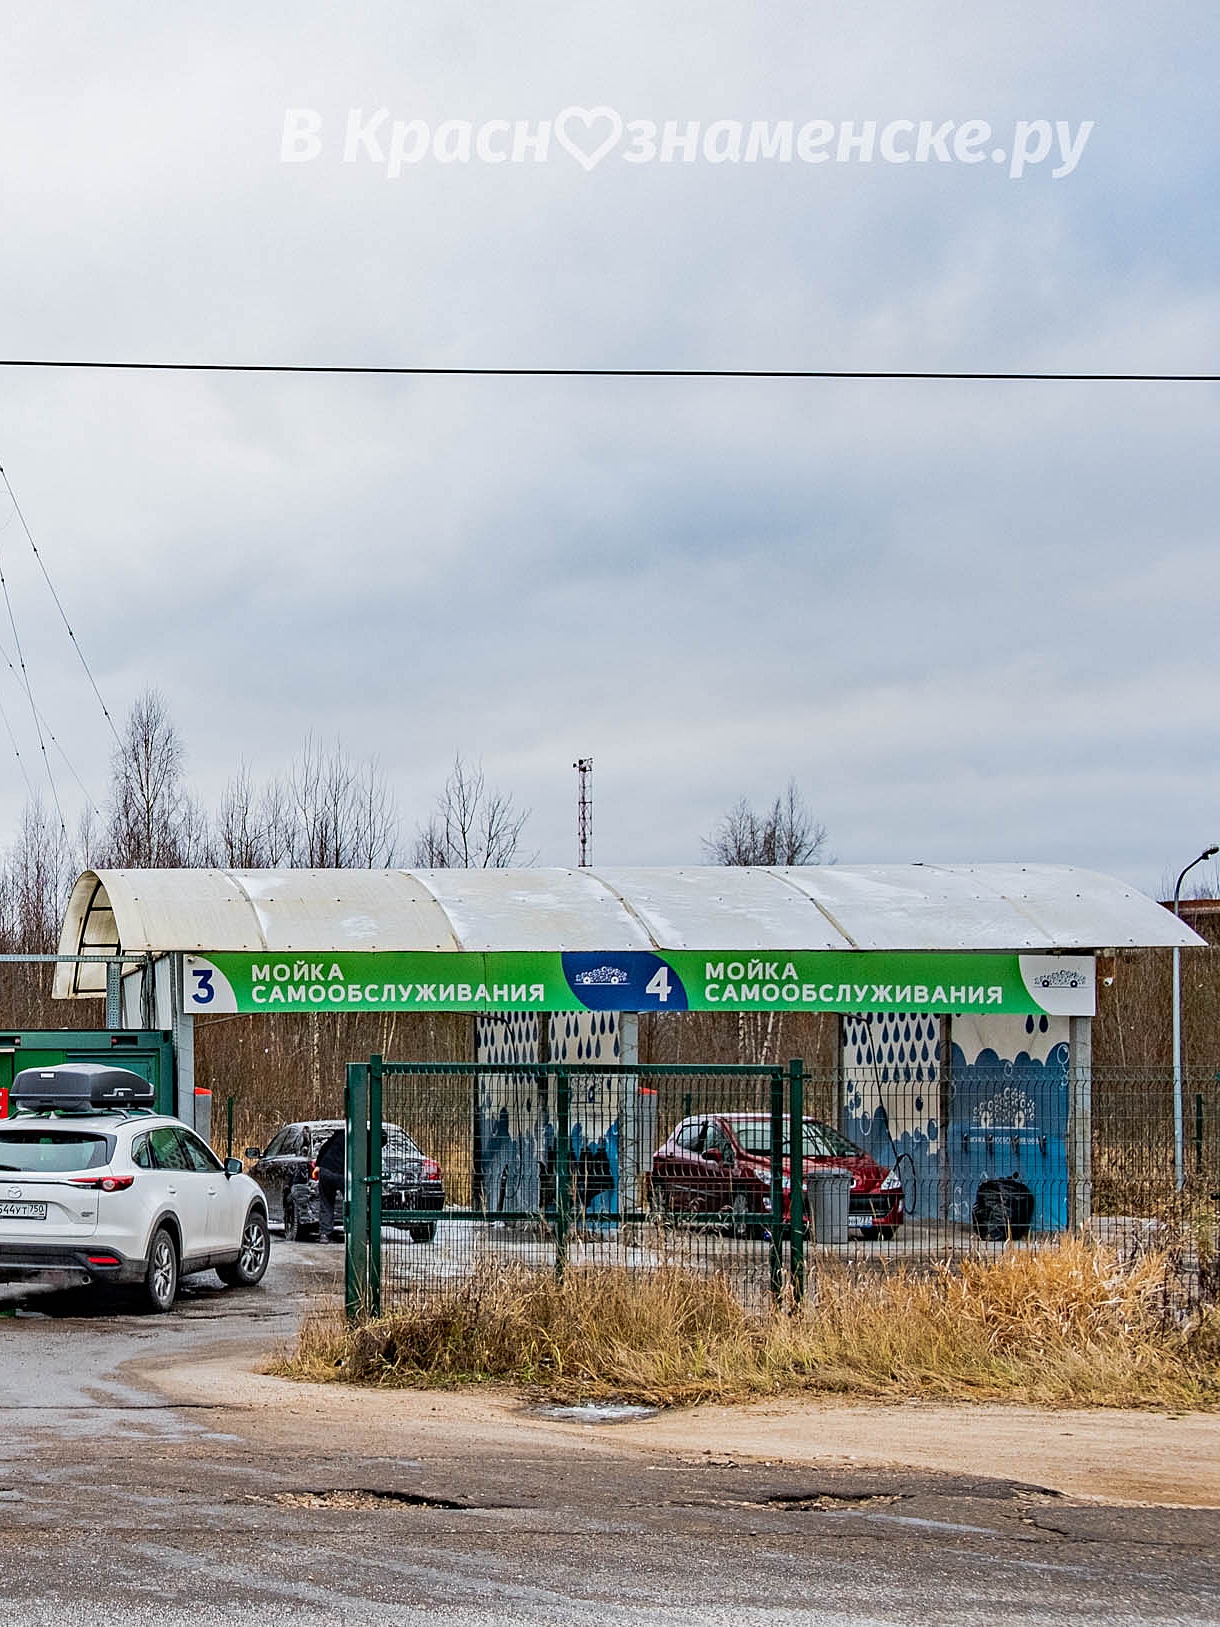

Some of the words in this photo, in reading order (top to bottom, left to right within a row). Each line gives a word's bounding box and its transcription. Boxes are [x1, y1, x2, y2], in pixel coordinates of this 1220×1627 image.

[252, 961, 343, 981] МОЙКА
[706, 960, 798, 980] МОЙКА
[192, 969, 214, 1003] 3
[252, 984, 544, 1003] САМООБСЛУЖИВАНИЯ
[646, 966, 671, 1001] 4
[706, 984, 1002, 1003] САМООБСЛУЖИВАНИЯ
